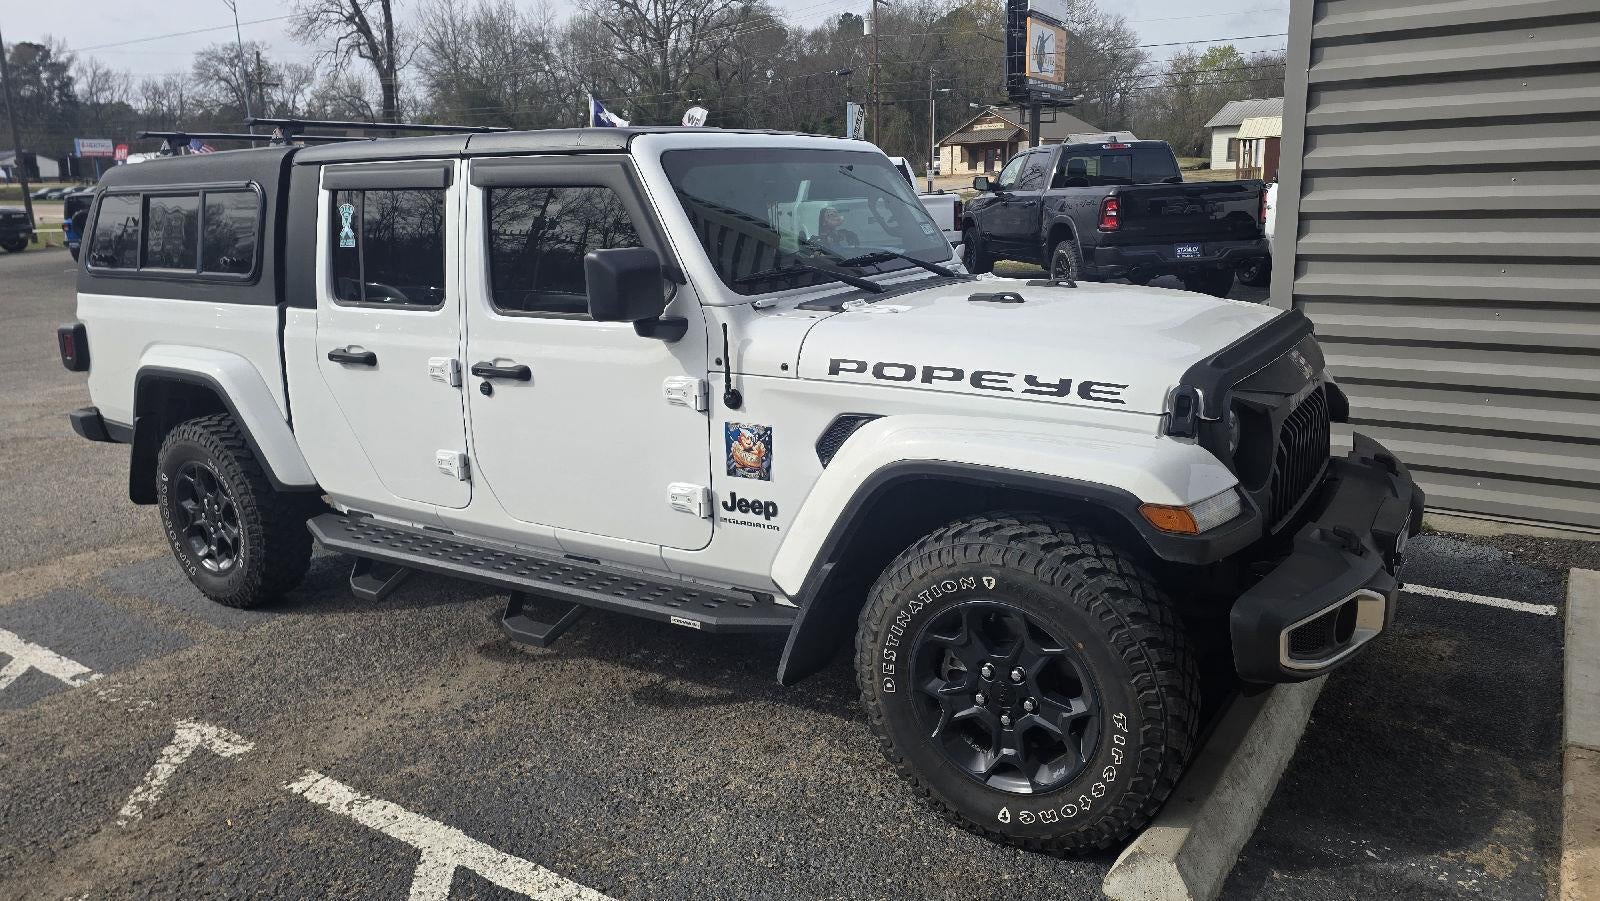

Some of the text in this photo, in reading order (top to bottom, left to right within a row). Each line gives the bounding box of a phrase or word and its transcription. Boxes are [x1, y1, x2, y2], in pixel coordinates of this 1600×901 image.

[828, 357, 1129, 405] POPEYE
[722, 491, 778, 521] Jeep
[728, 518, 780, 532] GLADIATOR
[883, 576, 977, 693] DESTINATION
